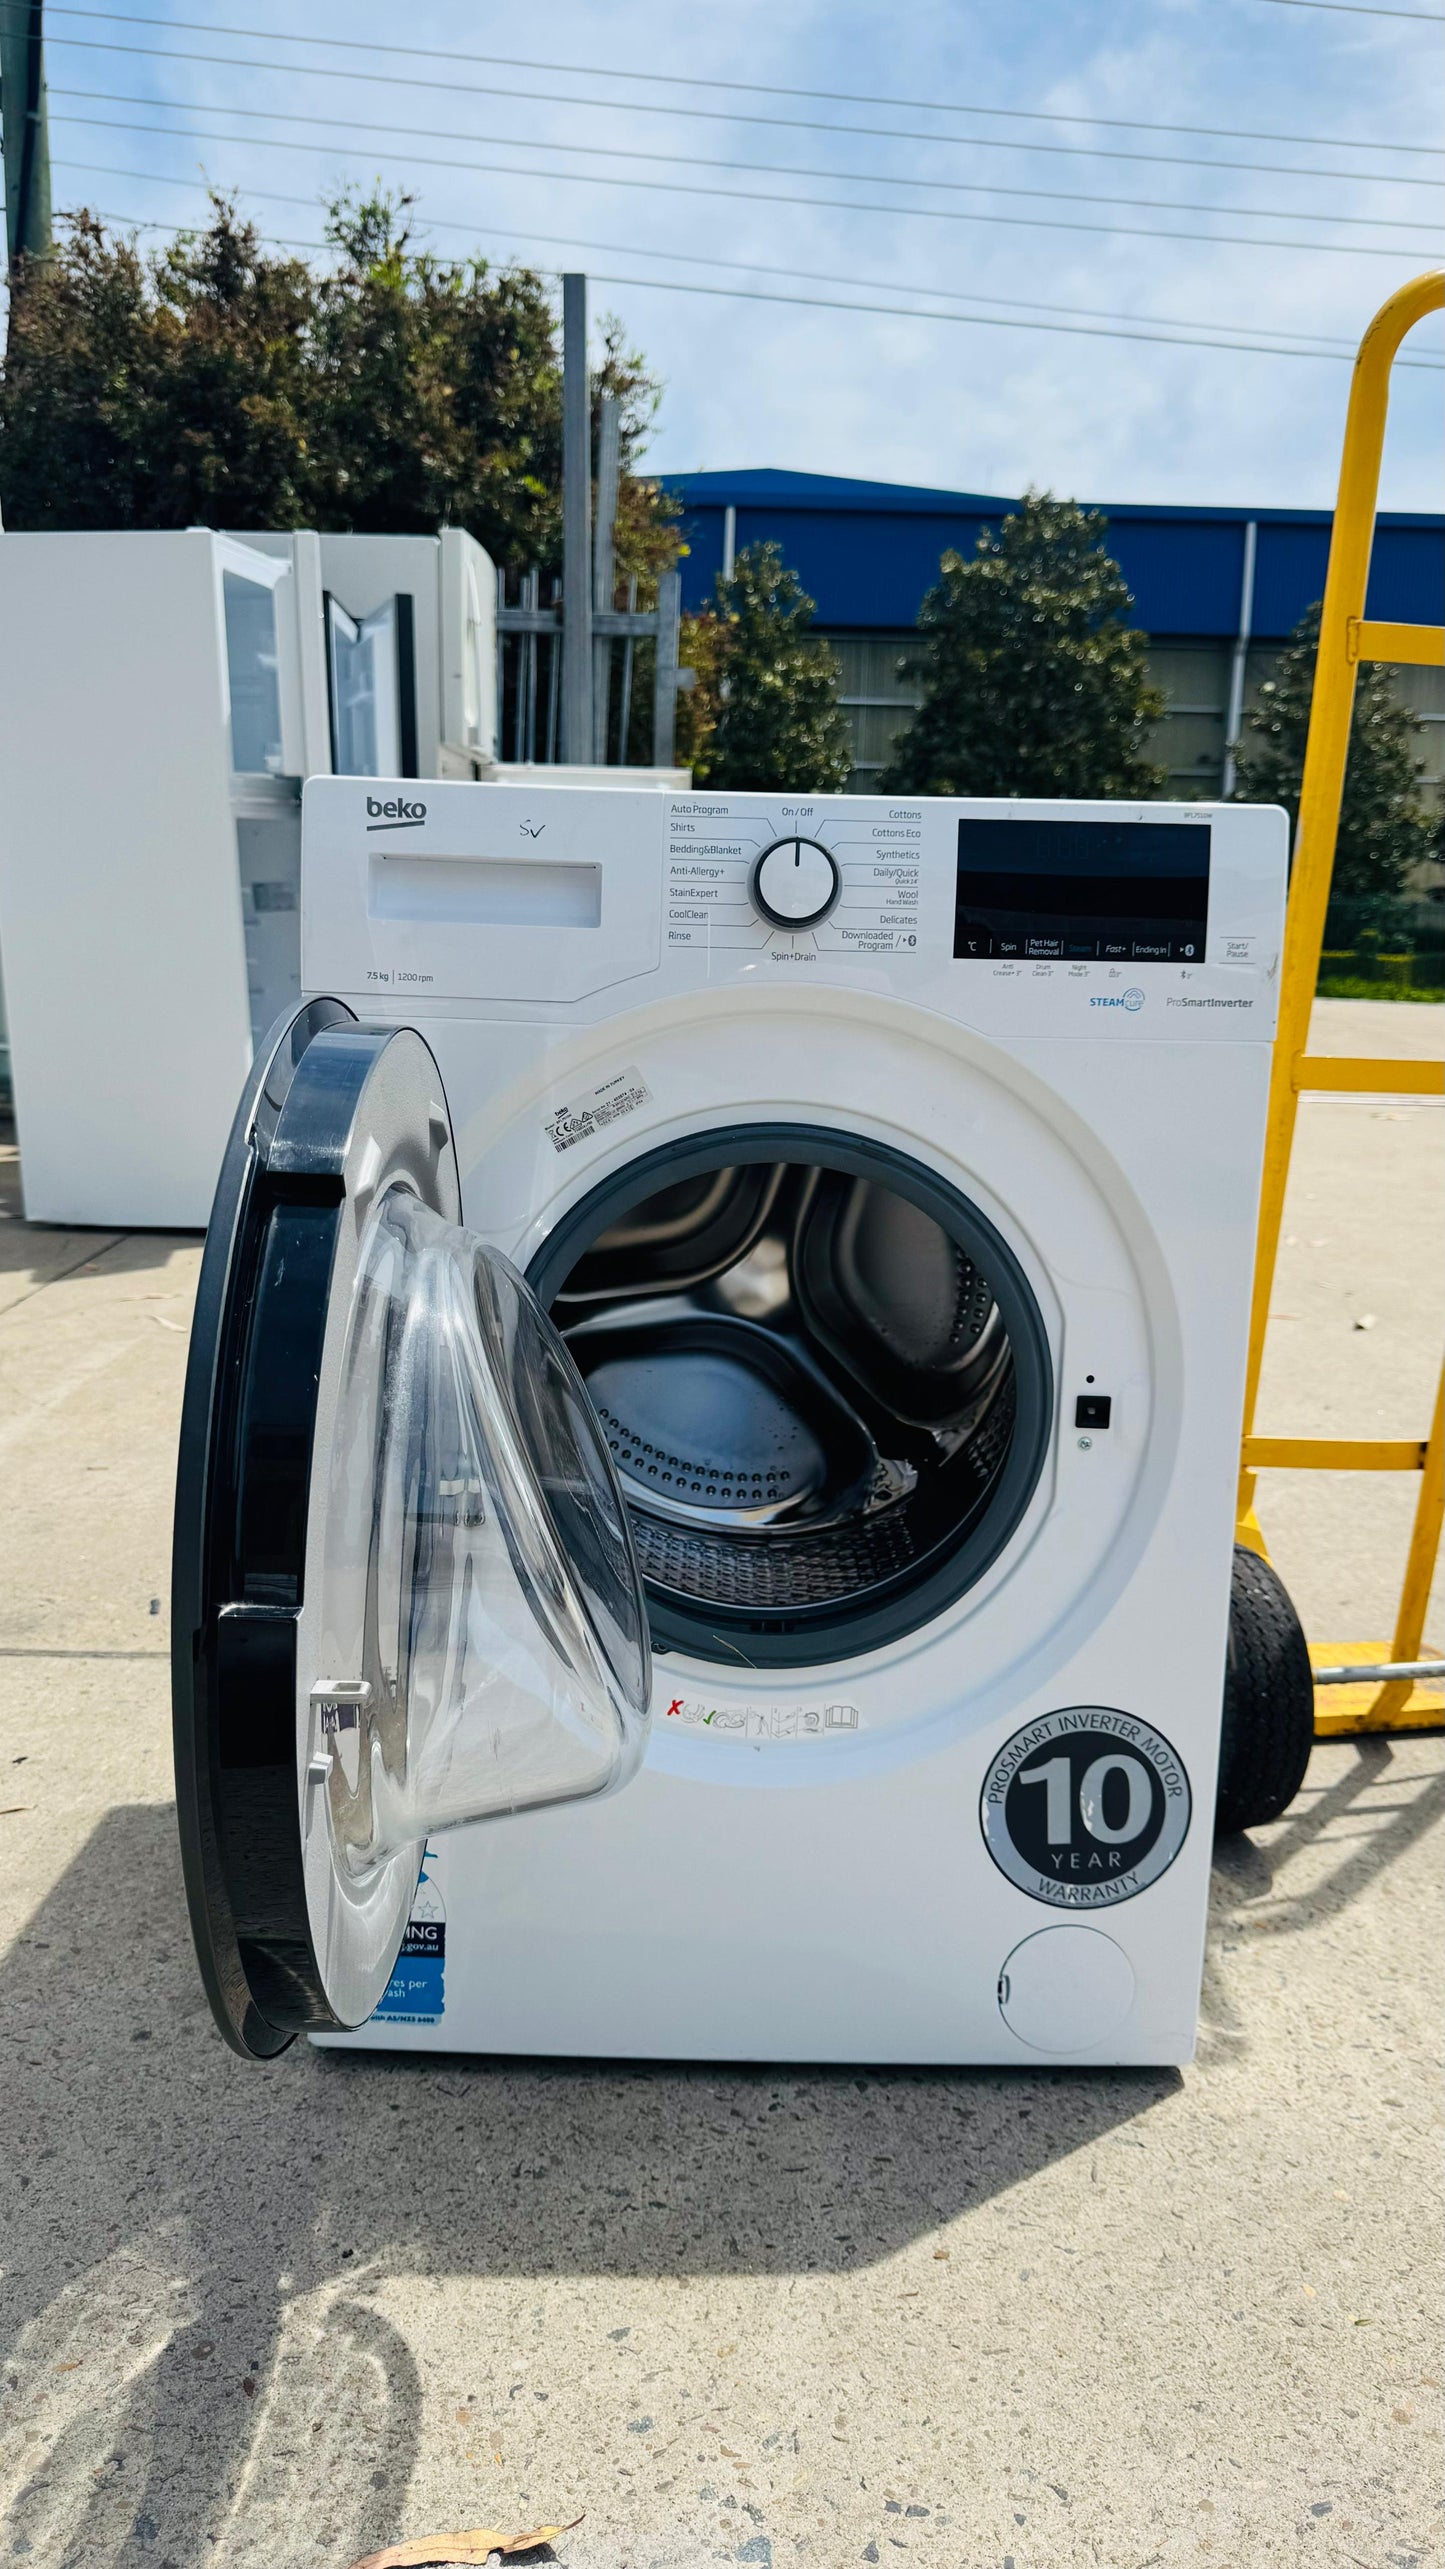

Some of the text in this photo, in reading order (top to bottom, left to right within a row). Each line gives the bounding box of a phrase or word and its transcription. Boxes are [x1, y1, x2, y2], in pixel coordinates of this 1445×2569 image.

[366, 796, 427, 820] beko
[670, 804, 729, 816] Auto Program
[781, 807, 794, 816] On
[800, 807, 814, 816] Off
[889, 809, 922, 819] Cottons
[670, 822, 695, 832] Shirts
[872, 828, 921, 838] Cottons Eco
[670, 844, 742, 856] Bedding&Blanket
[876, 850, 920, 860] Synthetics
[670, 866, 725, 878] Anti-Allergy+
[873, 868, 919, 878] Daily/Quick
[669, 888, 718, 899] StainExpert
[898, 890, 919, 899] Wool
[669, 909, 709, 919] CoolClean
[880, 915, 918, 924] Delicates
[668, 931, 691, 940] Rinse
[841, 930, 893, 940] Downloaded
[858, 940, 893, 950] Program
[1000, 942, 1017, 952] Spin
[1030, 939, 1059, 947] Pet Hair
[1226, 942, 1249, 950] Start/
[1029, 947, 1059, 955] Removal
[1135, 945, 1159, 955] Ending
[1226, 950, 1249, 958] Pause
[771, 951, 817, 962] Spin+Drain
[366, 971, 389, 982] 7.5 kg
[398, 972, 434, 983] 1200 rpm
[1166, 997, 1254, 1008] ProSmartInverter
[594, 1086, 606, 1095] MADE
[554, 1106, 569, 1118] beko
[988, 1713, 1183, 1804] PROSMART INVERTER MOTOR
[1018, 1753, 1153, 1845] 10
[1051, 1851, 1121, 1870] YEAR
[1039, 1871, 1139, 1902] WARRANTY
[408, 1979, 428, 1991] per
